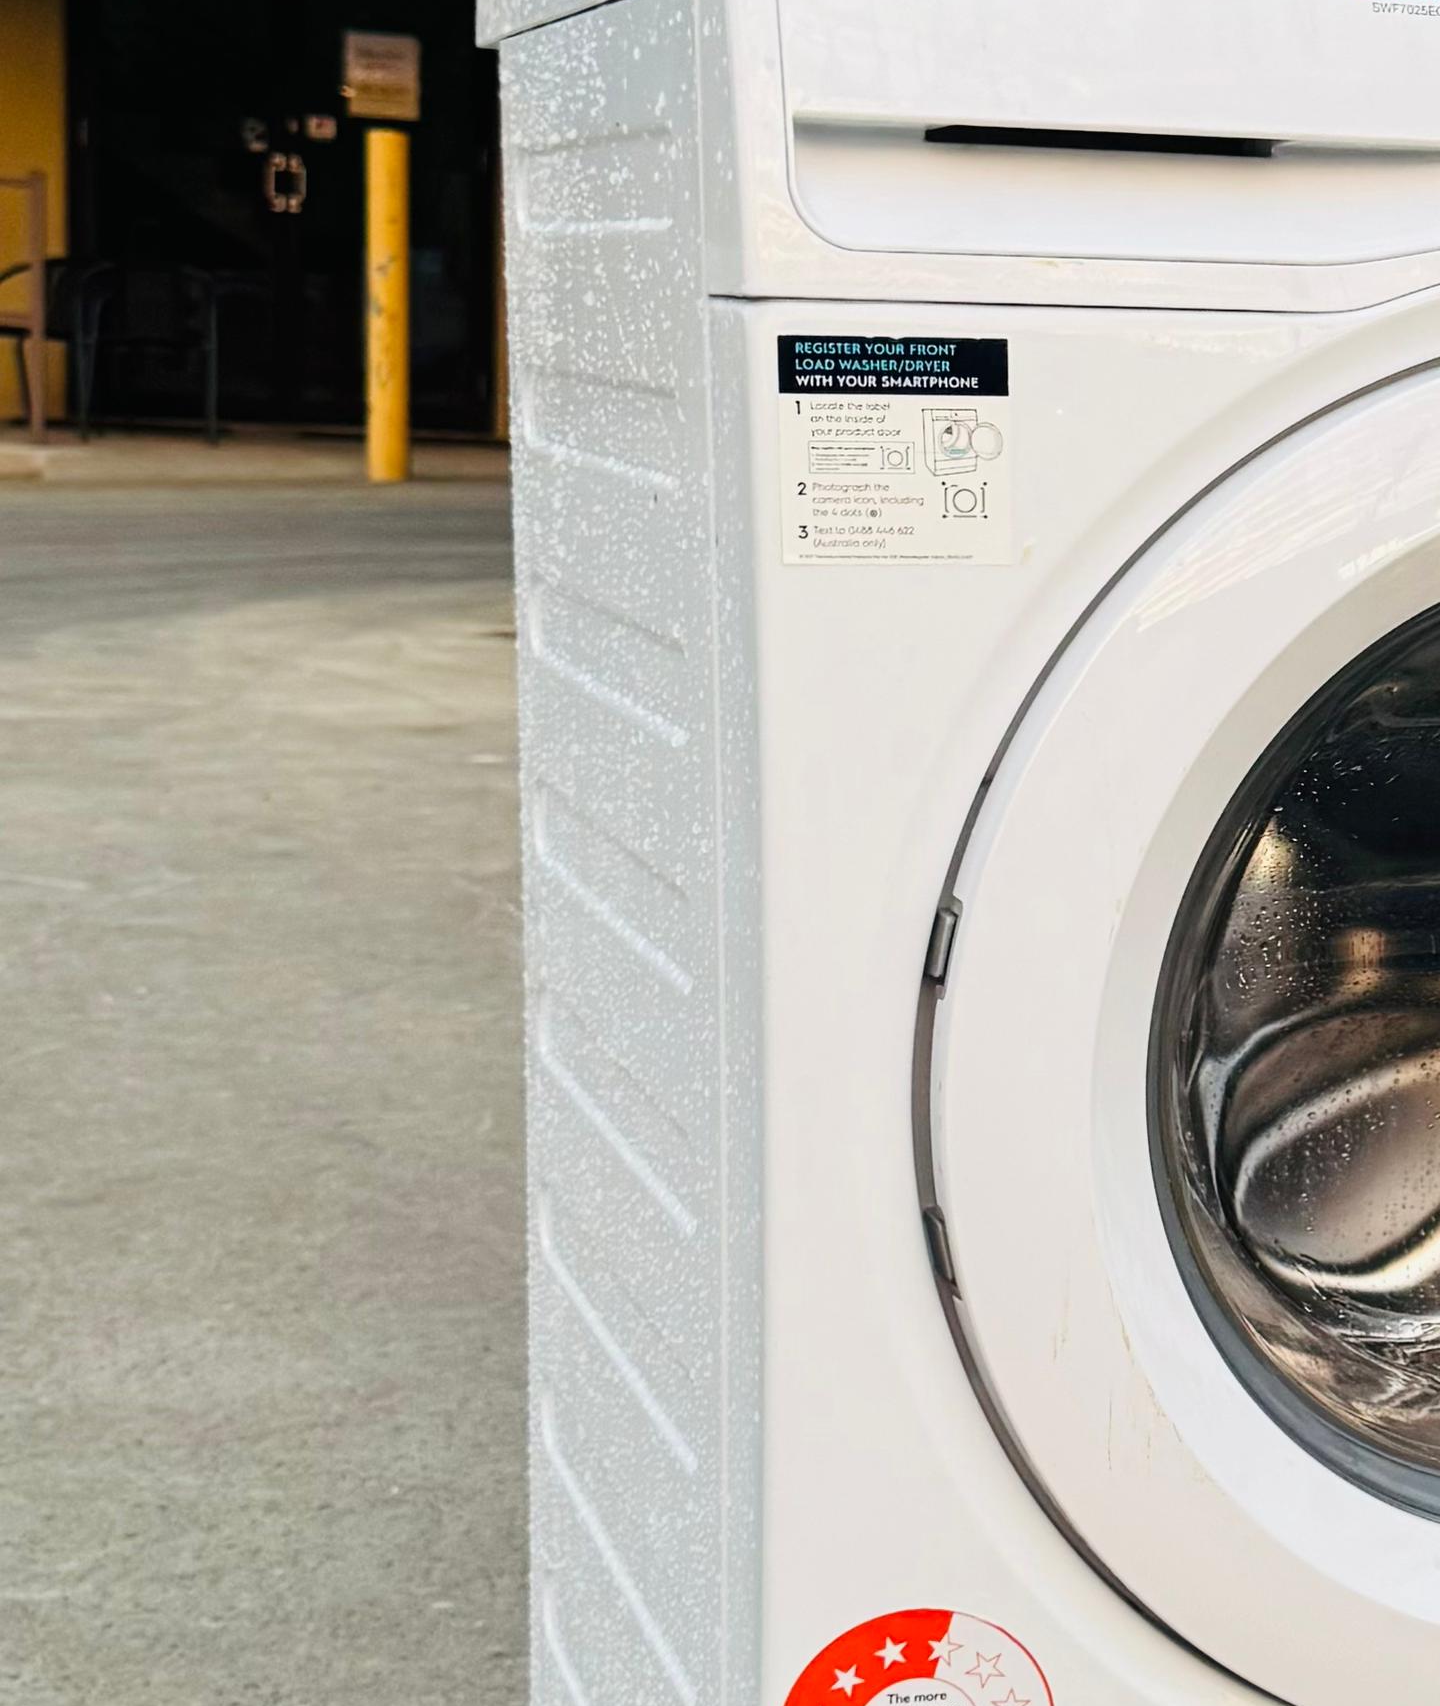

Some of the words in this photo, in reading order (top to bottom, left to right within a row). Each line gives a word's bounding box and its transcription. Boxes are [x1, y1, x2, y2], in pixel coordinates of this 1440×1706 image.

[795, 342, 861, 355] REGISTER
[865, 343, 905, 356] YOUR
[910, 344, 957, 356] FRONT
[795, 359, 835, 371] LOAD
[838, 359, 950, 373] WASHER/DRYER
[795, 375, 833, 388] WITH
[836, 375, 877, 388] YOUR
[881, 376, 979, 389] SMARTPHONE
[847, 402, 863, 411] the
[797, 482, 807, 496] 2
[873, 483, 890, 492] the
[798, 525, 809, 539] 3
[813, 526, 833, 535] Text
[835, 526, 846, 535] to
[888, 1693, 911, 1705] The
[914, 1692, 947, 1703] more
